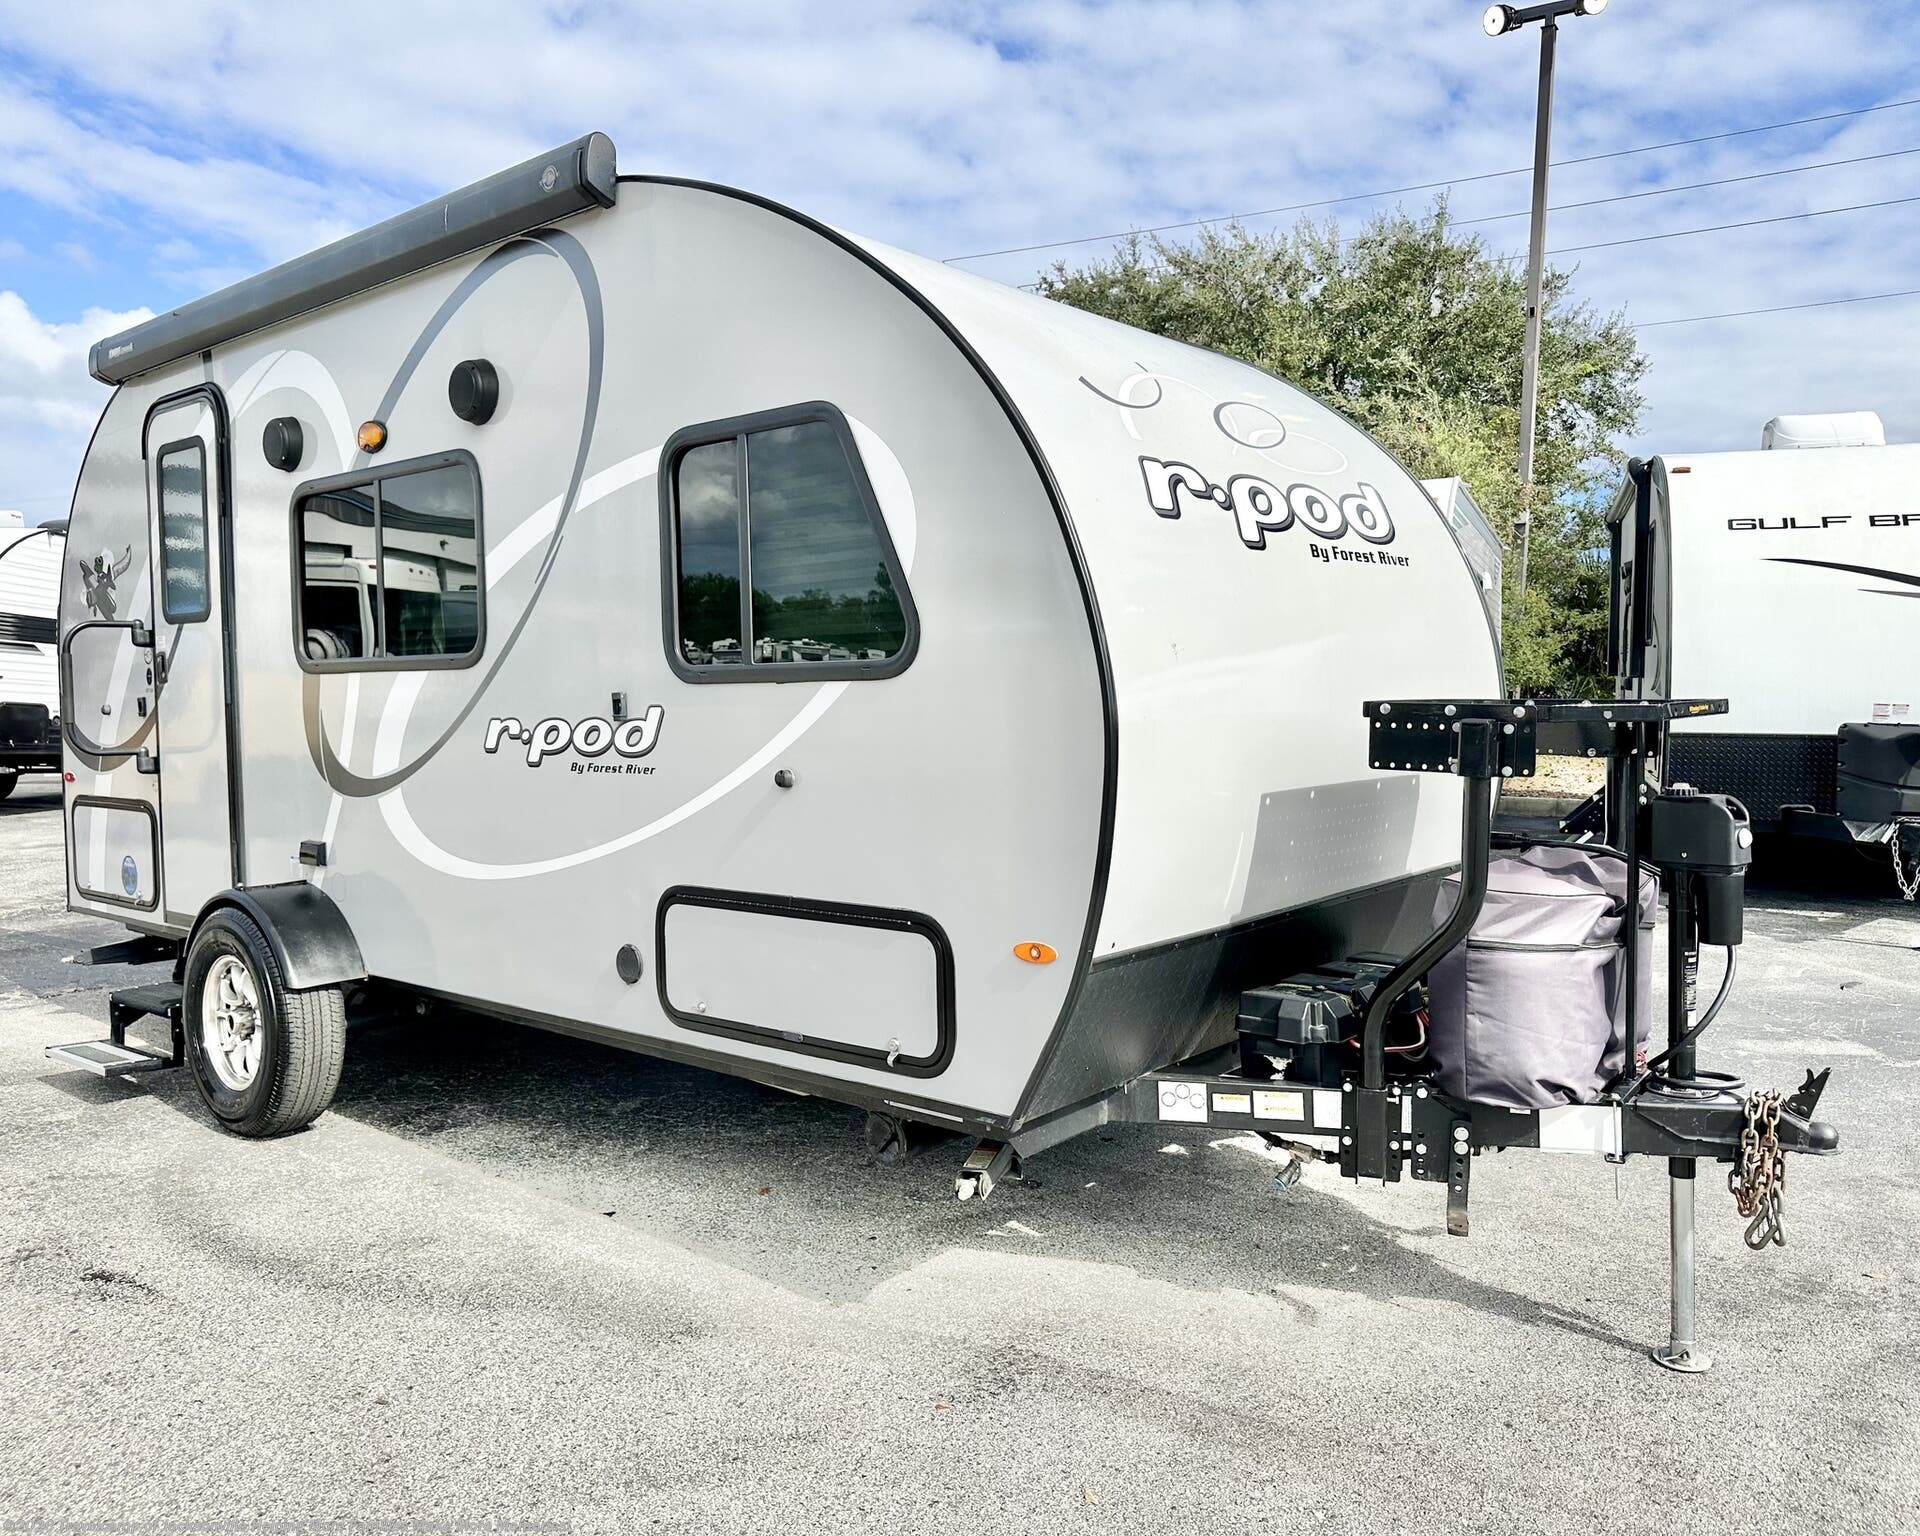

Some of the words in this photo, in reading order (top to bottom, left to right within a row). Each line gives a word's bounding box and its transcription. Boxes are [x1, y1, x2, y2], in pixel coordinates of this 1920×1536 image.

[1728, 516, 1852, 530] GULF
[1309, 543, 1330, 563] By
[1331, 545, 1377, 564] Forest
[1377, 550, 1410, 567] River
[570, 762, 585, 775] By
[586, 762, 623, 774] Forest
[625, 763, 656, 775] River
